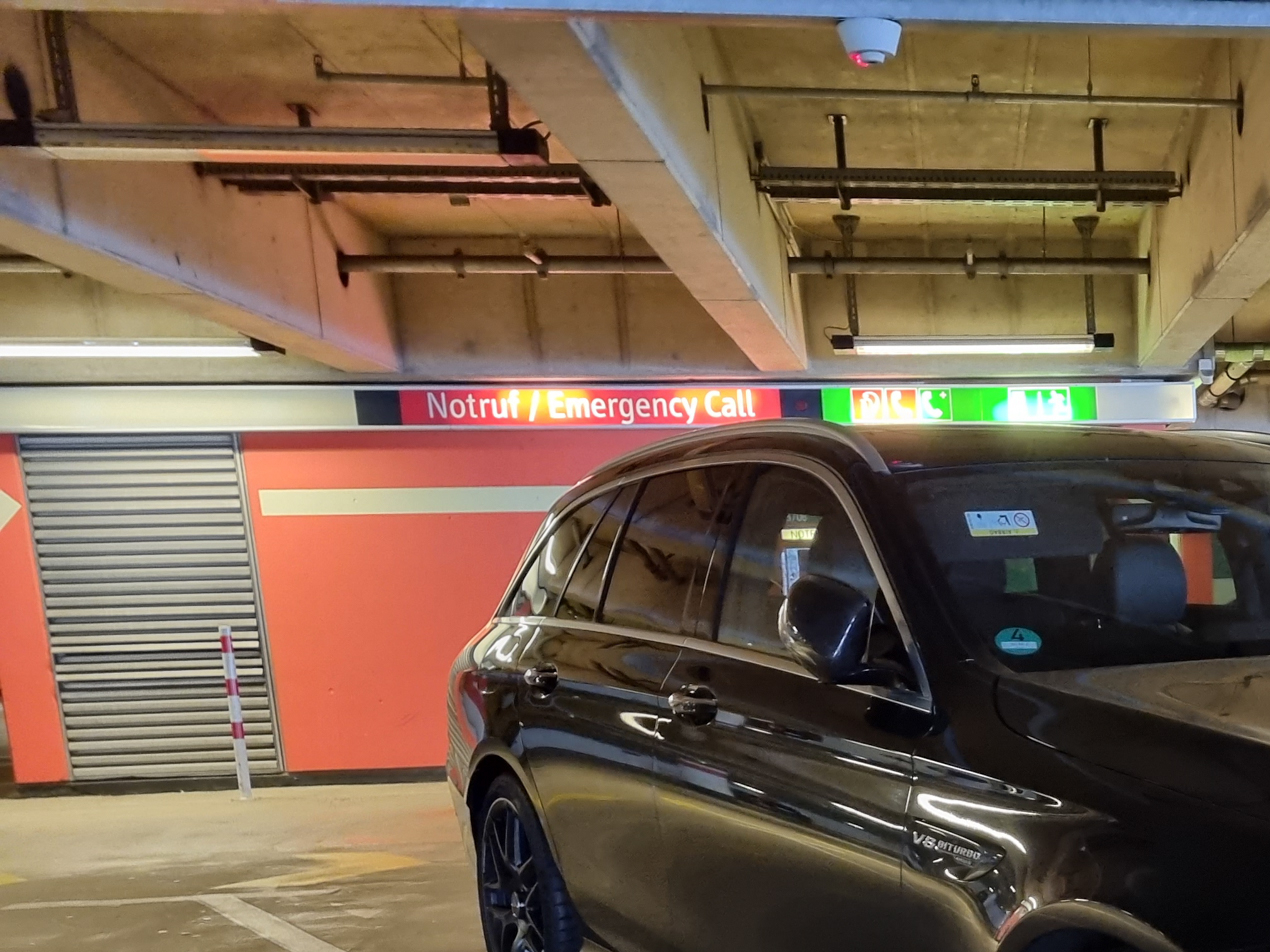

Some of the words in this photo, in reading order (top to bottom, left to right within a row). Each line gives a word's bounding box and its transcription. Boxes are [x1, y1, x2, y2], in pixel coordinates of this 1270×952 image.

[427, 389, 519, 418] Notruf
[528, 389, 540, 422] /
[547, 389, 698, 425] Emergency
[704, 388, 756, 418] Call
[1011, 628, 1025, 641] 4
[912, 831, 937, 849] V8
[937, 840, 982, 860] BITURBO
